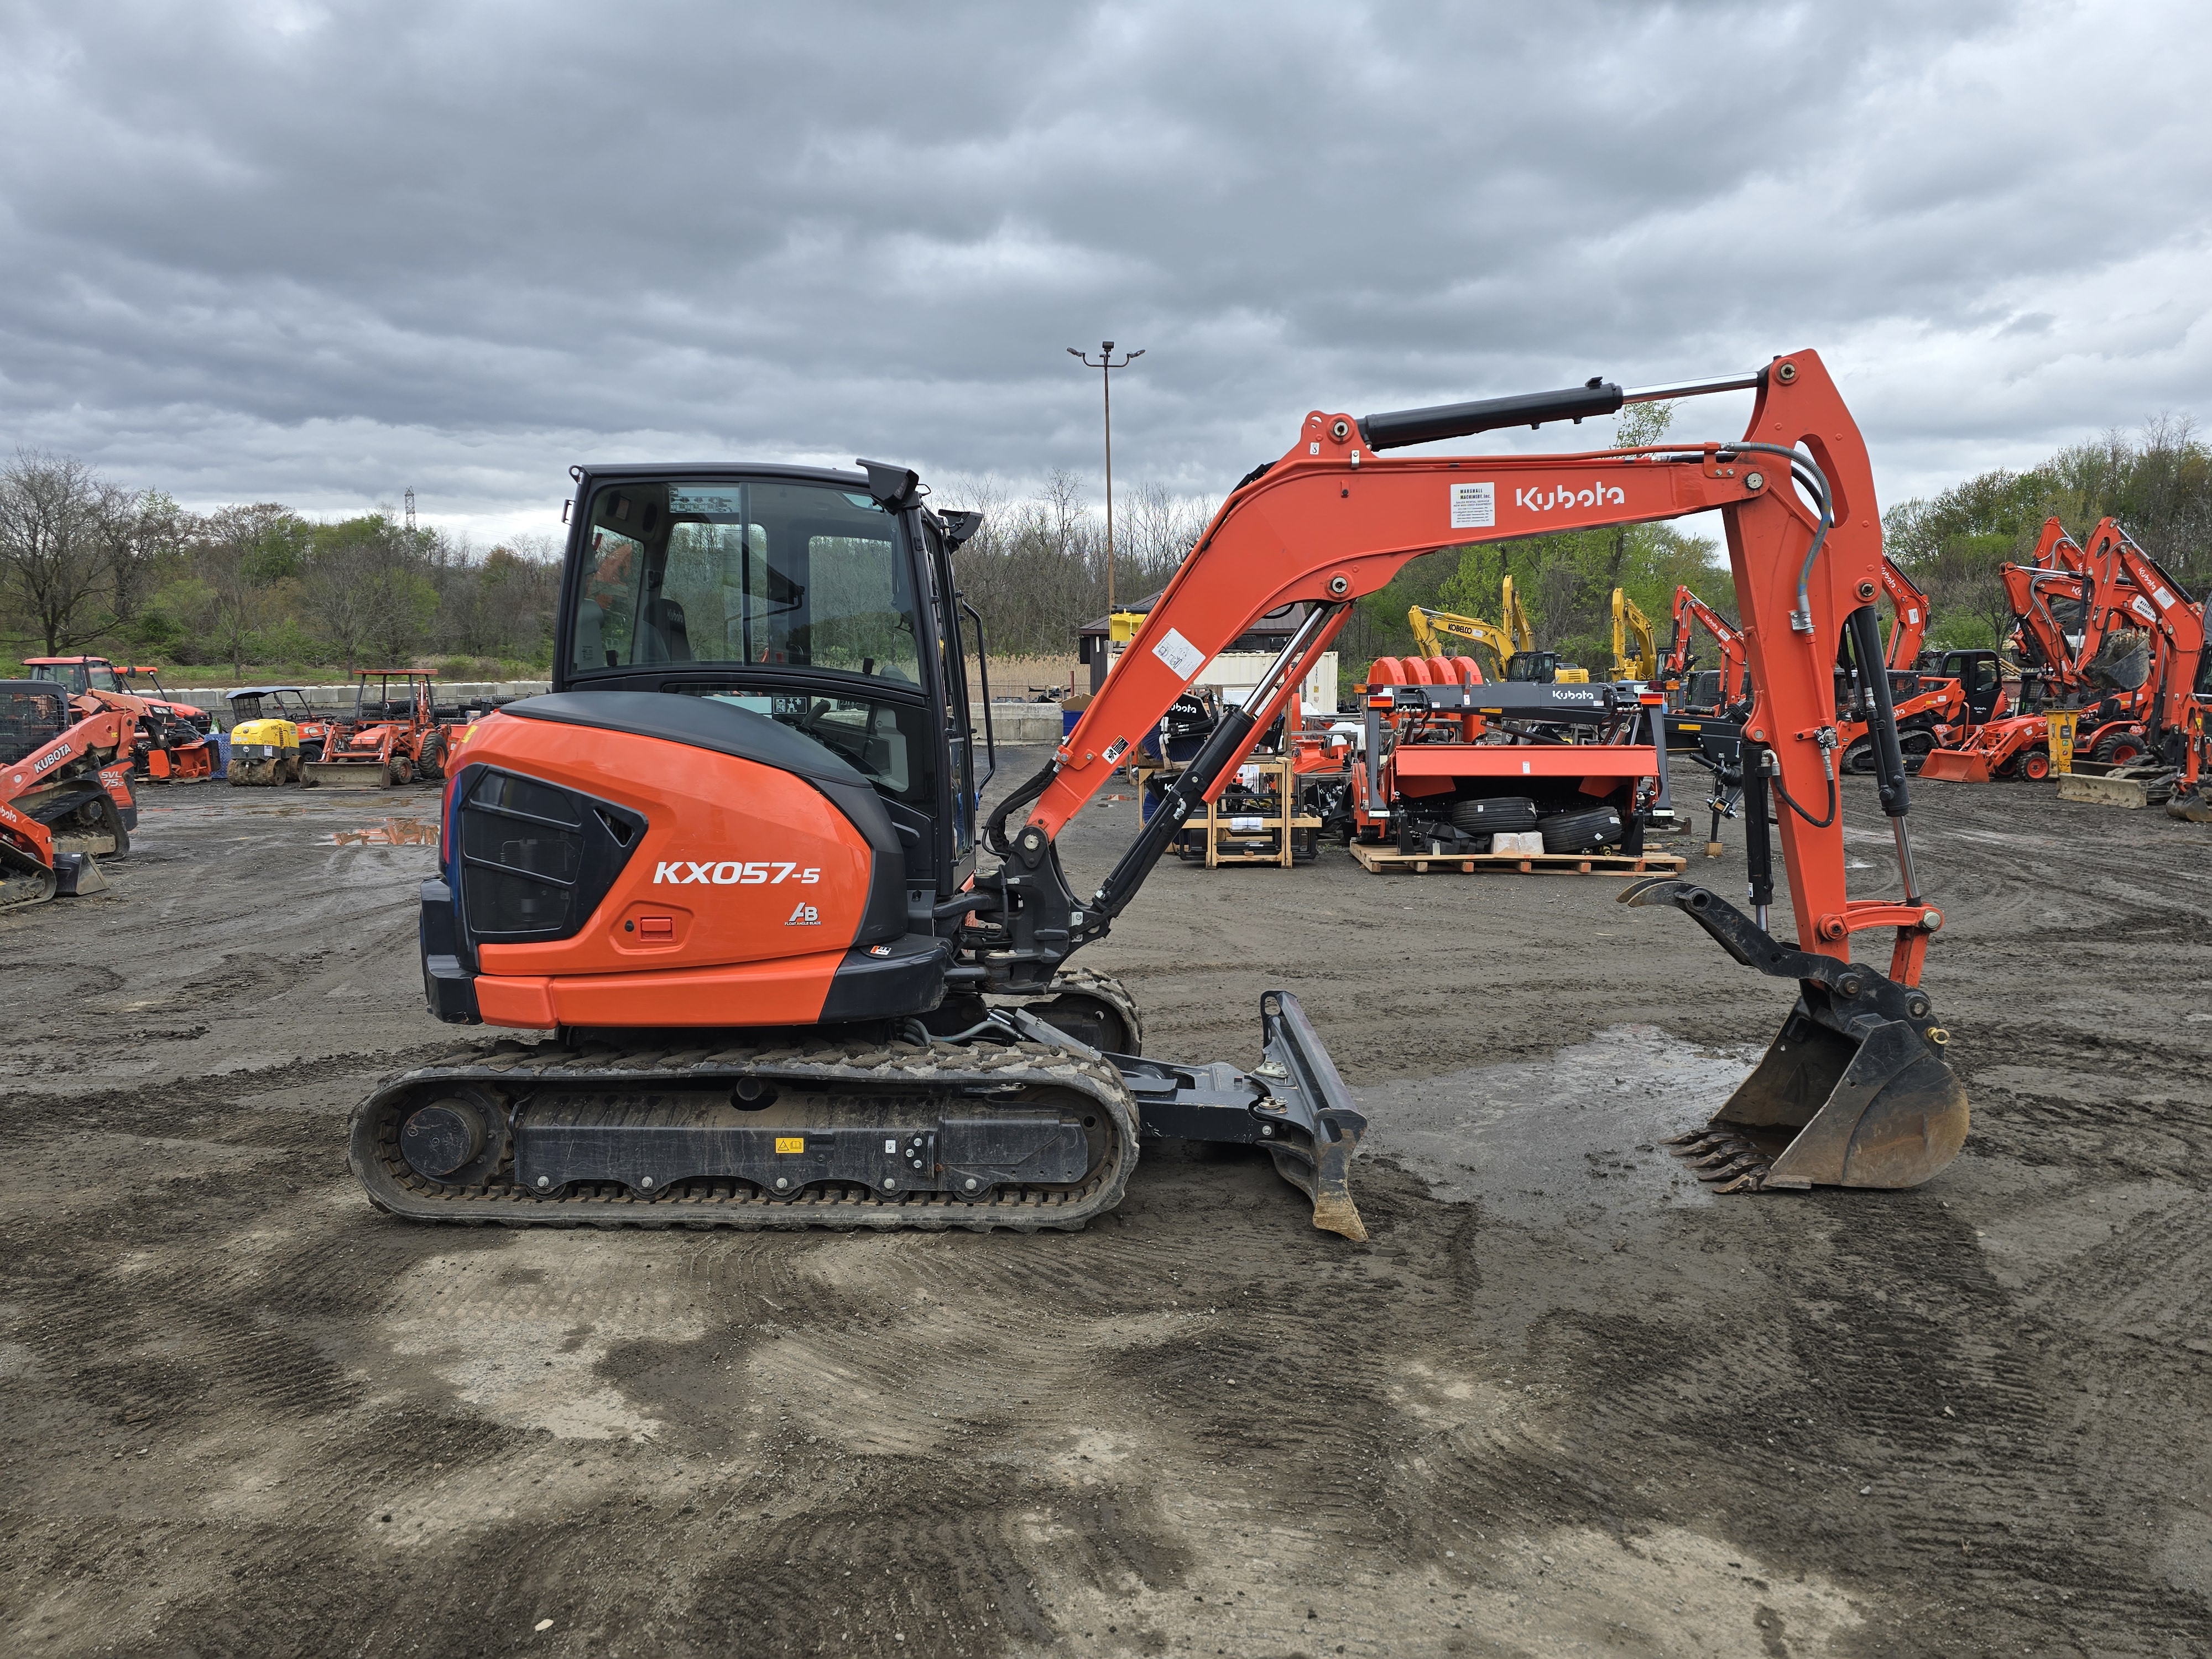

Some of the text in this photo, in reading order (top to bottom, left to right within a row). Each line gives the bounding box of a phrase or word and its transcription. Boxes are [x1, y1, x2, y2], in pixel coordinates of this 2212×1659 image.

[1516, 481, 1625, 512] Kubota
[2138, 567, 2156, 591] Kubota
[1448, 623, 1472, 634] KOBELCO
[1552, 690, 1594, 700] Kubota
[1168, 702, 1197, 713] ubota
[33, 744, 72, 774] KUBOTA
[101, 771, 122, 779] SVL
[653, 862, 821, 884] KX057-5
